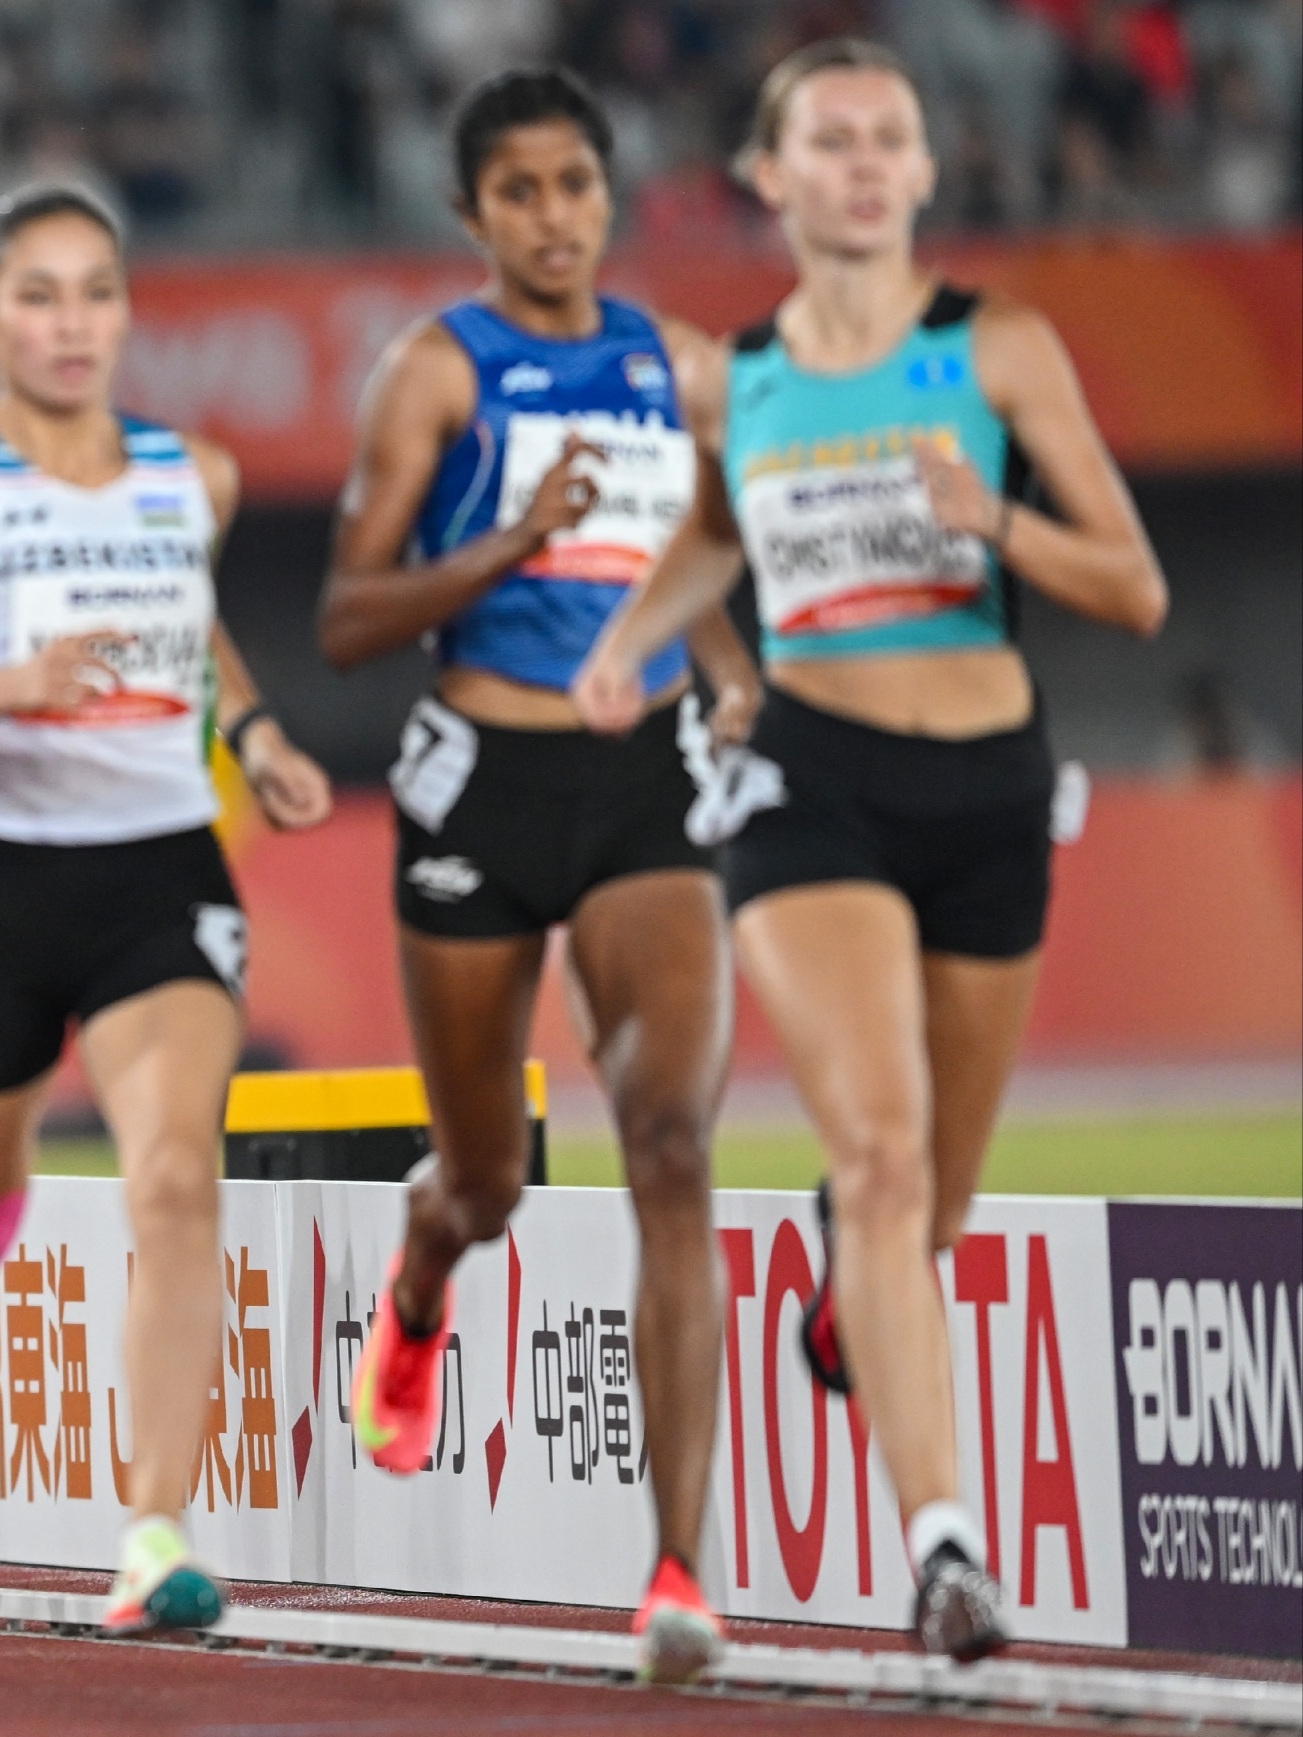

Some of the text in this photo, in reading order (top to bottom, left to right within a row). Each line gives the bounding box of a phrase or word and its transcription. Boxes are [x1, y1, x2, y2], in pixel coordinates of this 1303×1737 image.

[532, 1299, 647, 1485] 中部電
[1122, 1277, 1303, 1471] BORNA
[1138, 1493, 1303, 1589] SPORTS TECHNOL
